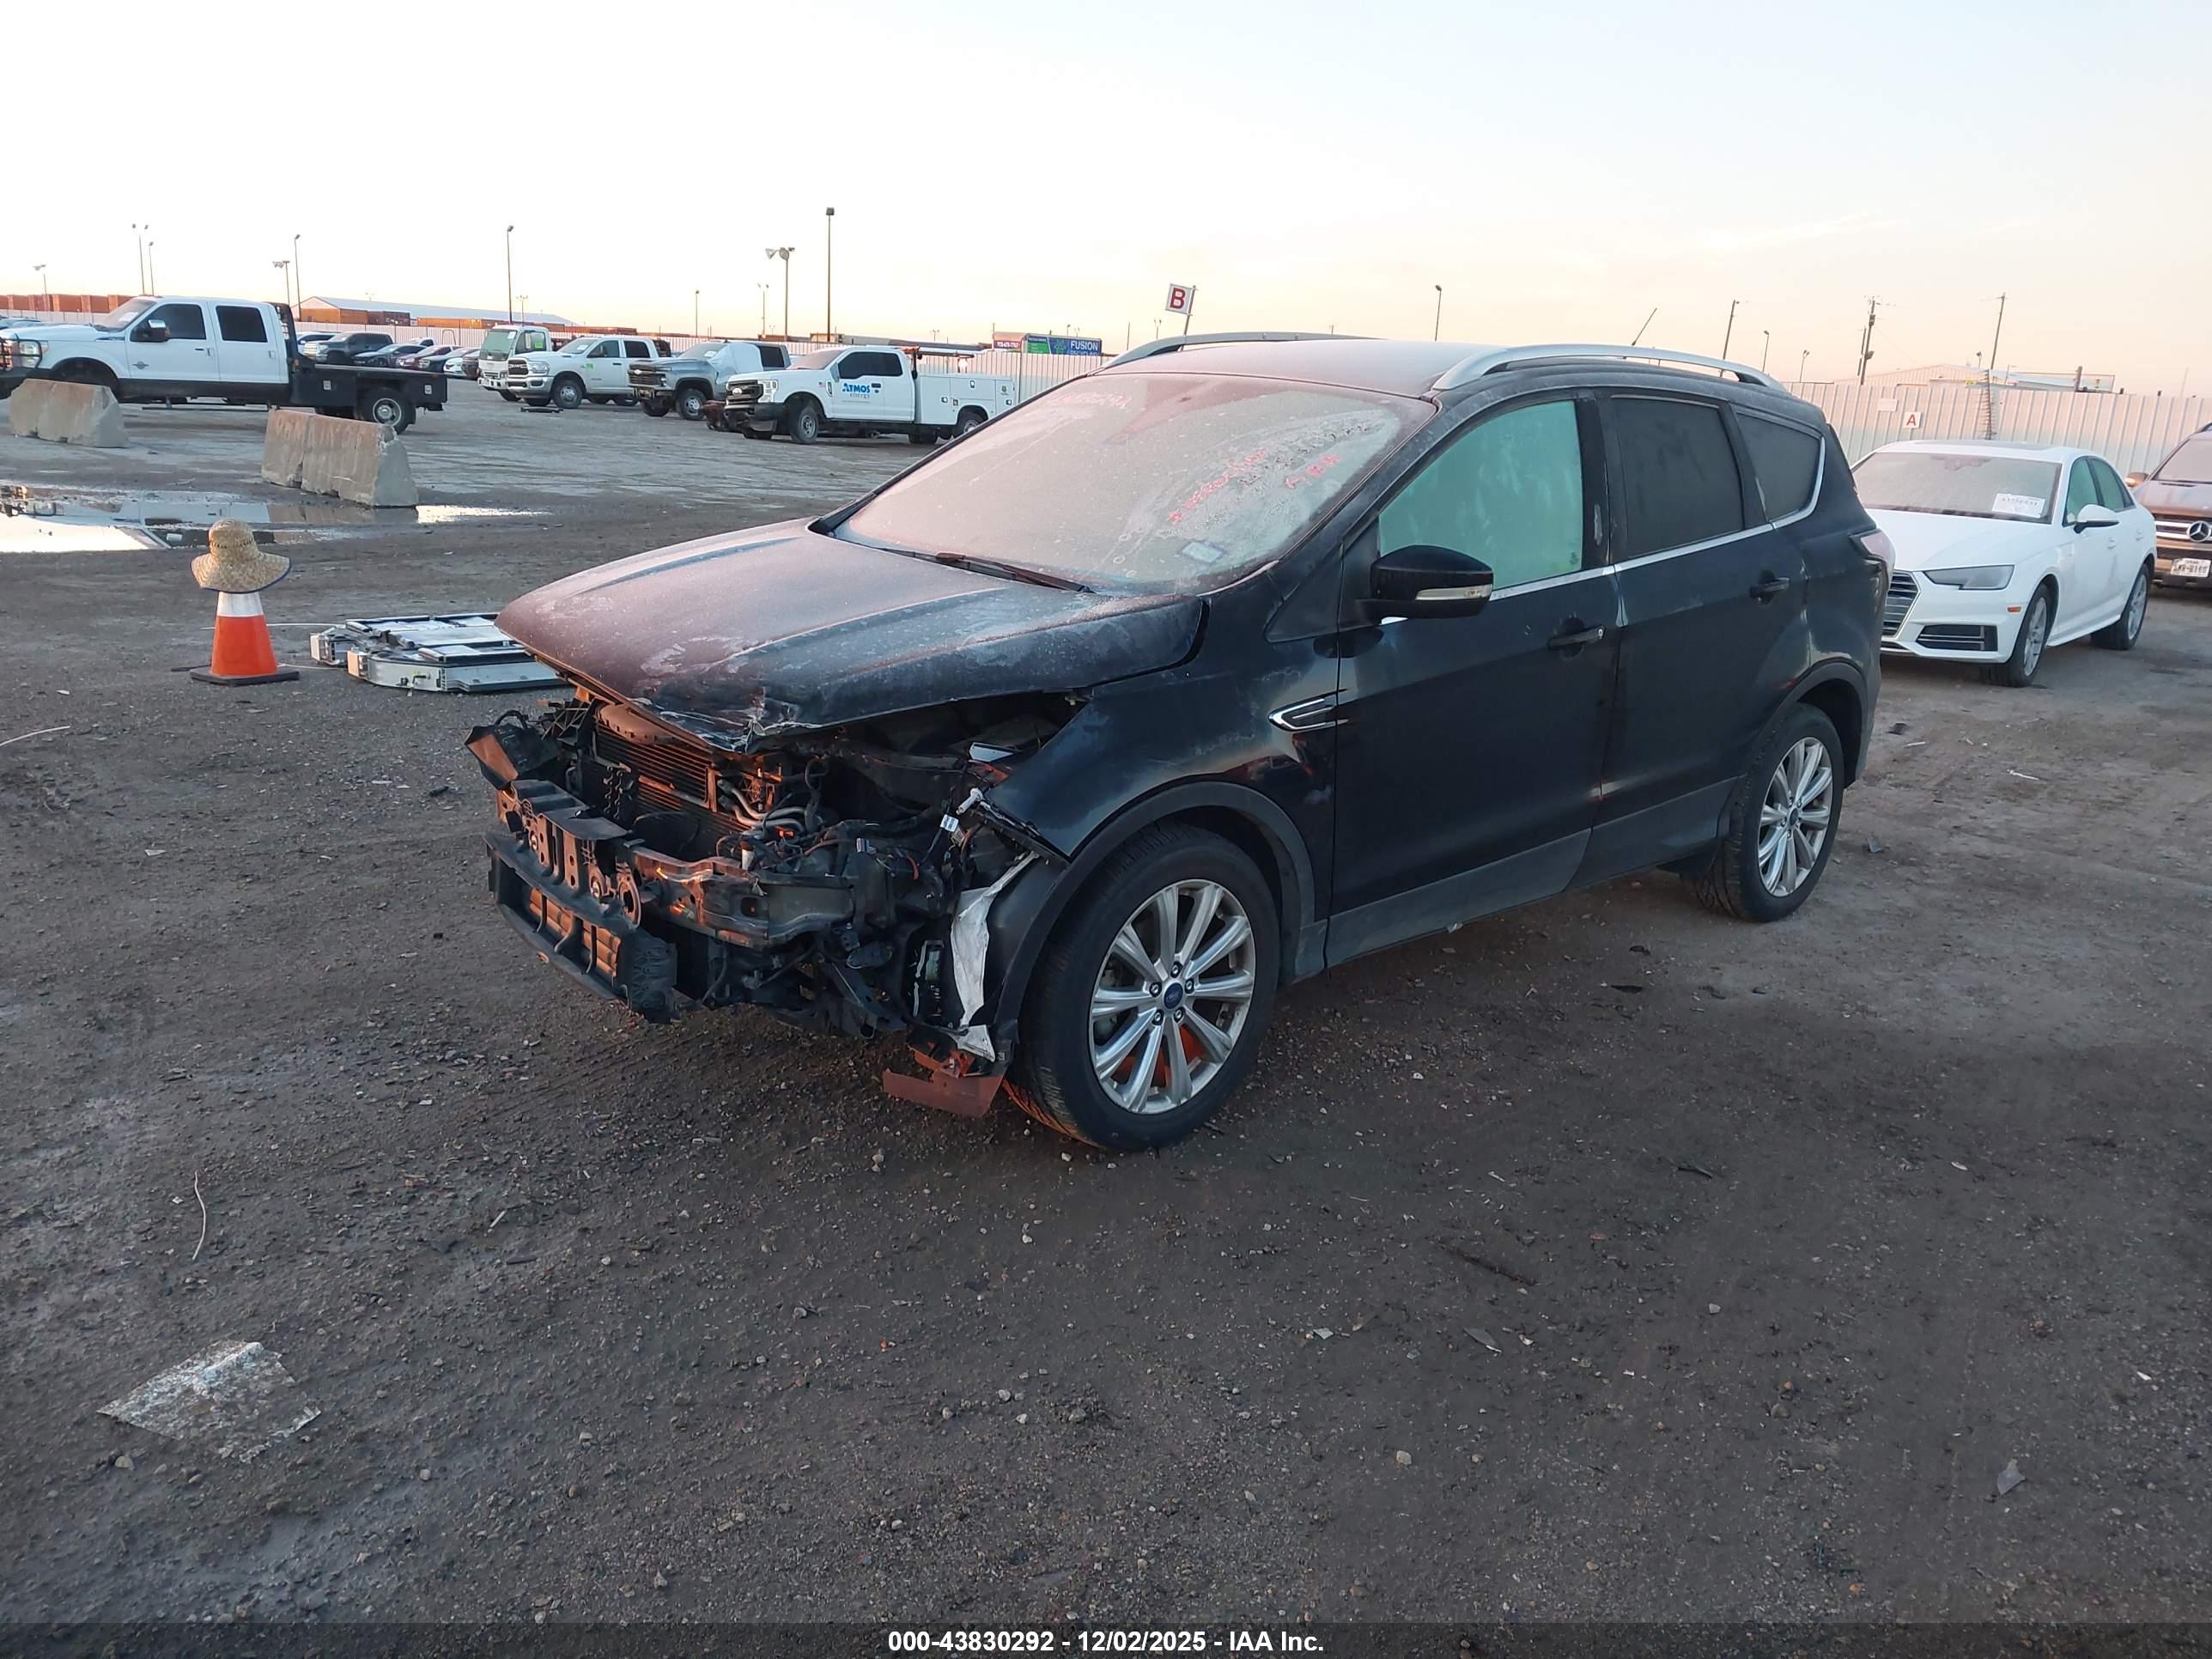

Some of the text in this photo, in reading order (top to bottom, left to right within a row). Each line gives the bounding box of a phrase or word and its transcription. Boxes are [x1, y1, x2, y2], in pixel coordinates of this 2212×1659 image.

[1170, 288, 1185, 308] B
[1070, 340, 1098, 350] FUSION
[842, 382, 871, 393] ATMOS
[1905, 414, 1916, 426] A
